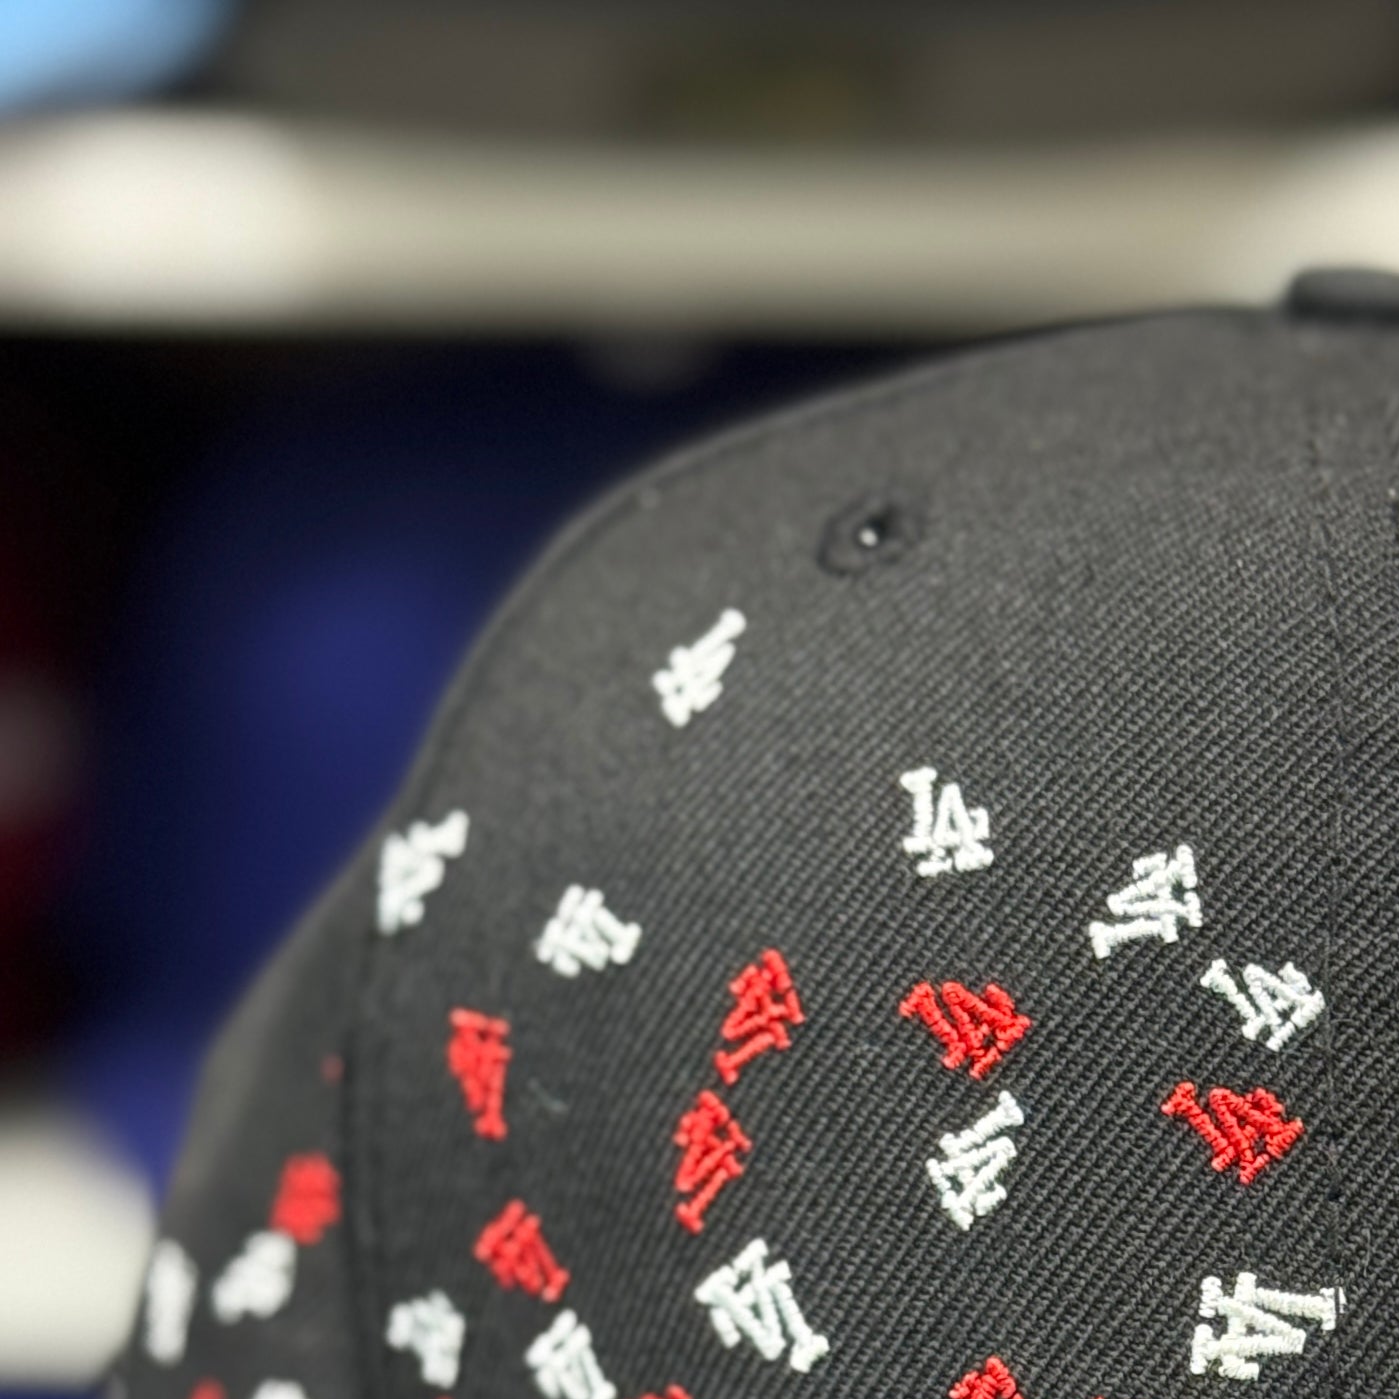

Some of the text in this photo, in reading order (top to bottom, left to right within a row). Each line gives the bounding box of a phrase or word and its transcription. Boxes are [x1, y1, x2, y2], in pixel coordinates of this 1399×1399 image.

[900, 766, 994, 877] LA
[1088, 843, 1202, 959] LA
[899, 981, 1032, 1080] LA
[1200, 958, 1325, 1051] LA
[926, 1091, 1024, 1231] LA
[1162, 1081, 1304, 1185] LA
[695, 1238, 829, 1373] LA
[1188, 1272, 1347, 1380] LA
